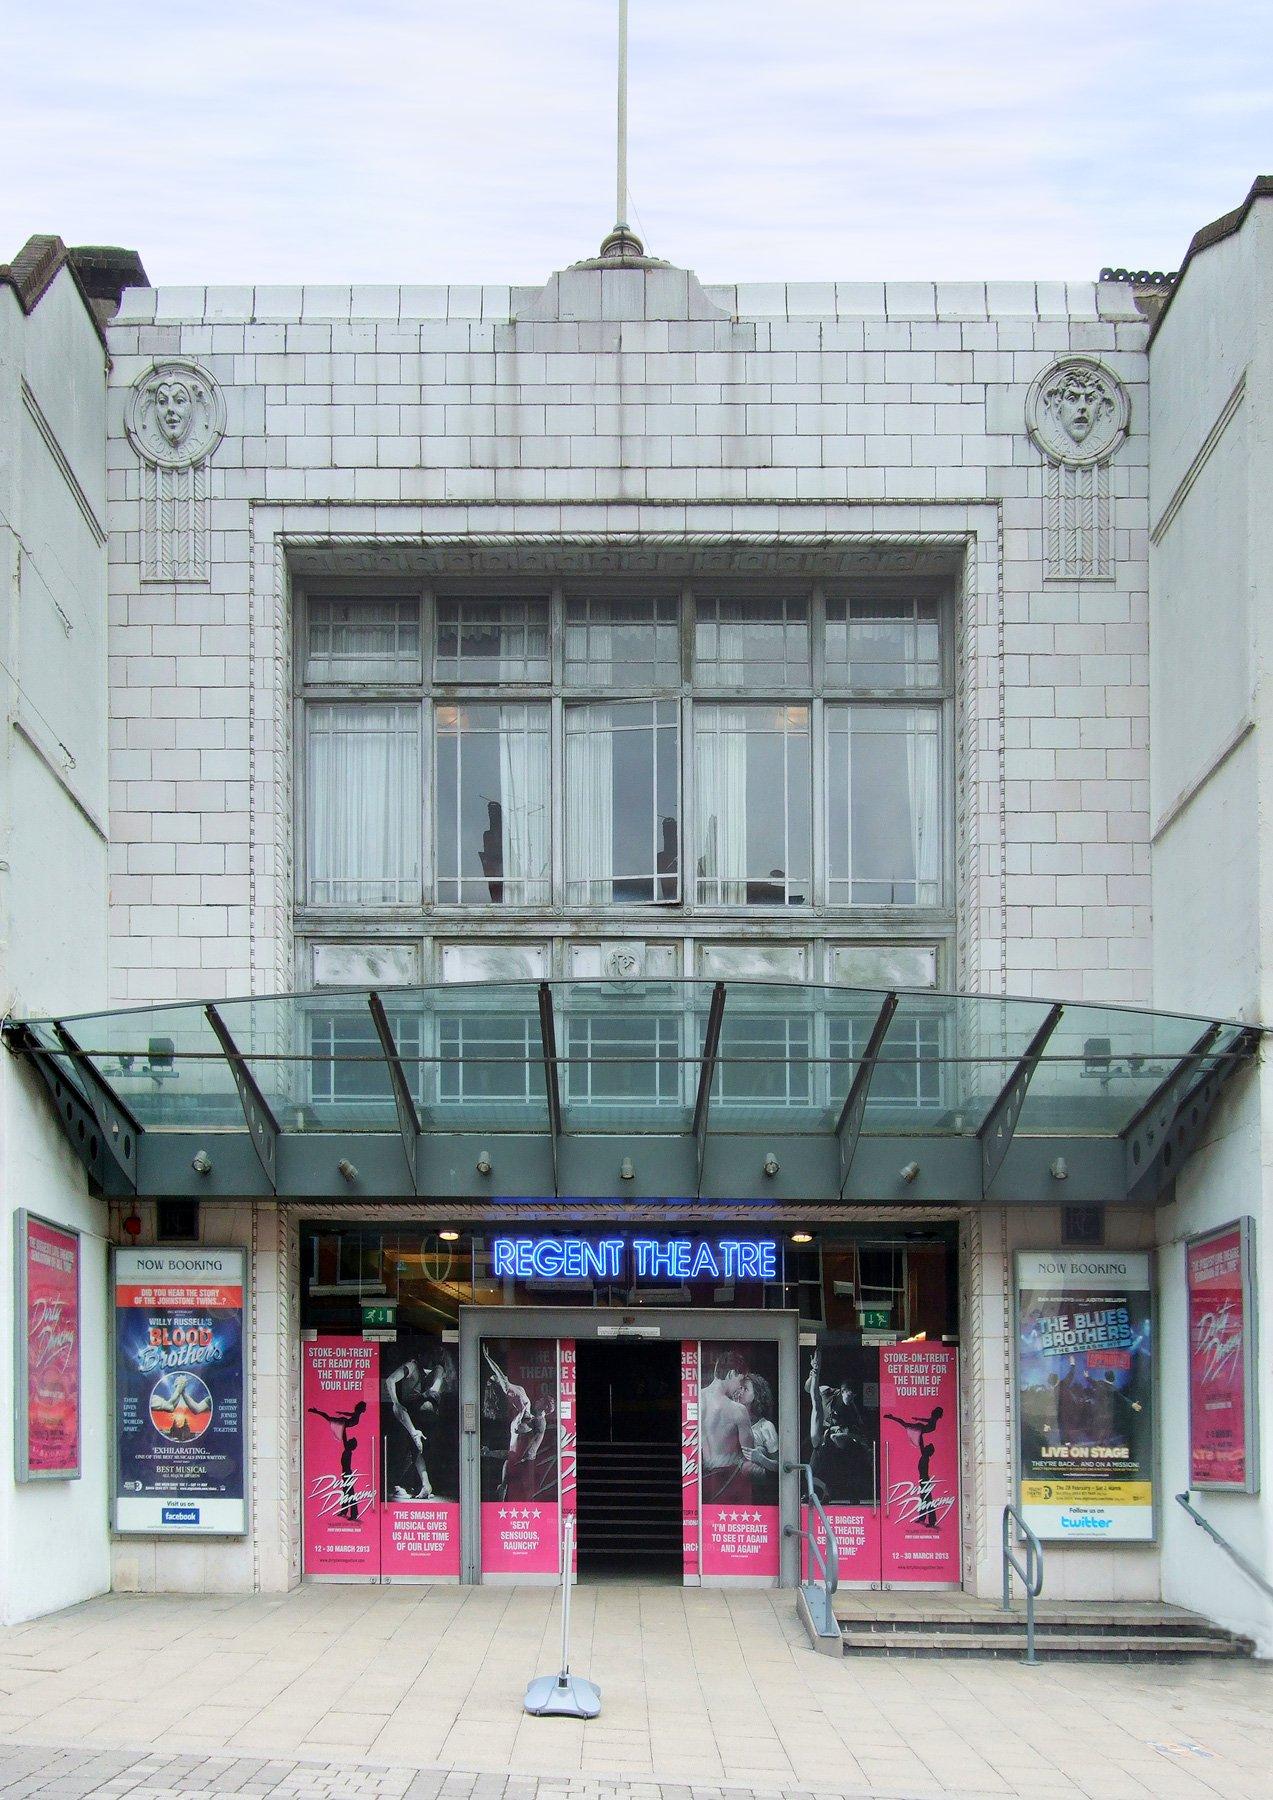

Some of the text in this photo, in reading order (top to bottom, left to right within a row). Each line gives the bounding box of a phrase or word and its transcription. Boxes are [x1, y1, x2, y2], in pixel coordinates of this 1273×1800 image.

[493, 1240, 777, 1278] REGENT THEATRE
[137, 1260, 222, 1270] NOW BOOKING
[1038, 1264, 1127, 1274] NOW BOOKING
[149, 1318, 213, 1326] WILLY RUSSELL'S
[1037, 1307, 1130, 1334] THE BLUES
[149, 1327, 213, 1347] BLOOD
[1042, 1323, 1131, 1348] BROTHERS
[309, 1348, 373, 1357] STOKE-ON-TRENT
[138, 1344, 223, 1372] Brothers
[884, 1353, 949, 1363] STOKE-ON-TRENT
[313, 1359, 370, 1368] GET READY FOR
[888, 1365, 947, 1374] GET READY FOR
[318, 1370, 365, 1379] THE TIME OF
[893, 1376, 942, 1385] THE TIME OF
[320, 1381, 362, 1390] YOUR LIFE!
[896, 1387, 939, 1396] YOUR LIFE!
[1041, 1447, 1130, 1458] LIVE ON STAGE
[308, 1468, 369, 1499] Dirty
[885, 1475, 947, 1505] Dirty
[317, 1484, 377, 1519] Dancing
[894, 1490, 955, 1527] Dancing
[165, 1512, 196, 1521] facebook
[393, 1512, 448, 1520] 'THE SMASH HIT
[835, 1516, 864, 1525] BIGGEST
[394, 1522, 447, 1530] MUSICAL GIVES
[510, 1521, 530, 1529] 'SEXY
[1061, 1516, 1112, 1528] twitter
[727, 1524, 768, 1532] DESPERATE
[835, 1526, 864, 1535] THEATRE
[392, 1532, 449, 1541] US ALL THE TIME
[501, 1532, 540, 1540] SENSUOUS,
[712, 1534, 768, 1543] TO SEE IT AGAIN
[856, 1537, 866, 1545] OF
[396, 1543, 445, 1551] OF OUR LIVES'
[504, 1542, 539, 1550] RAUNCHY'
[720, 1544, 735, 1553] AND
[737, 1544, 761, 1553] AGAIN'
[838, 1547, 857, 1555] TIME'
[913, 1552, 934, 1560] MARCH
[935, 1552, 949, 1560] 2013
